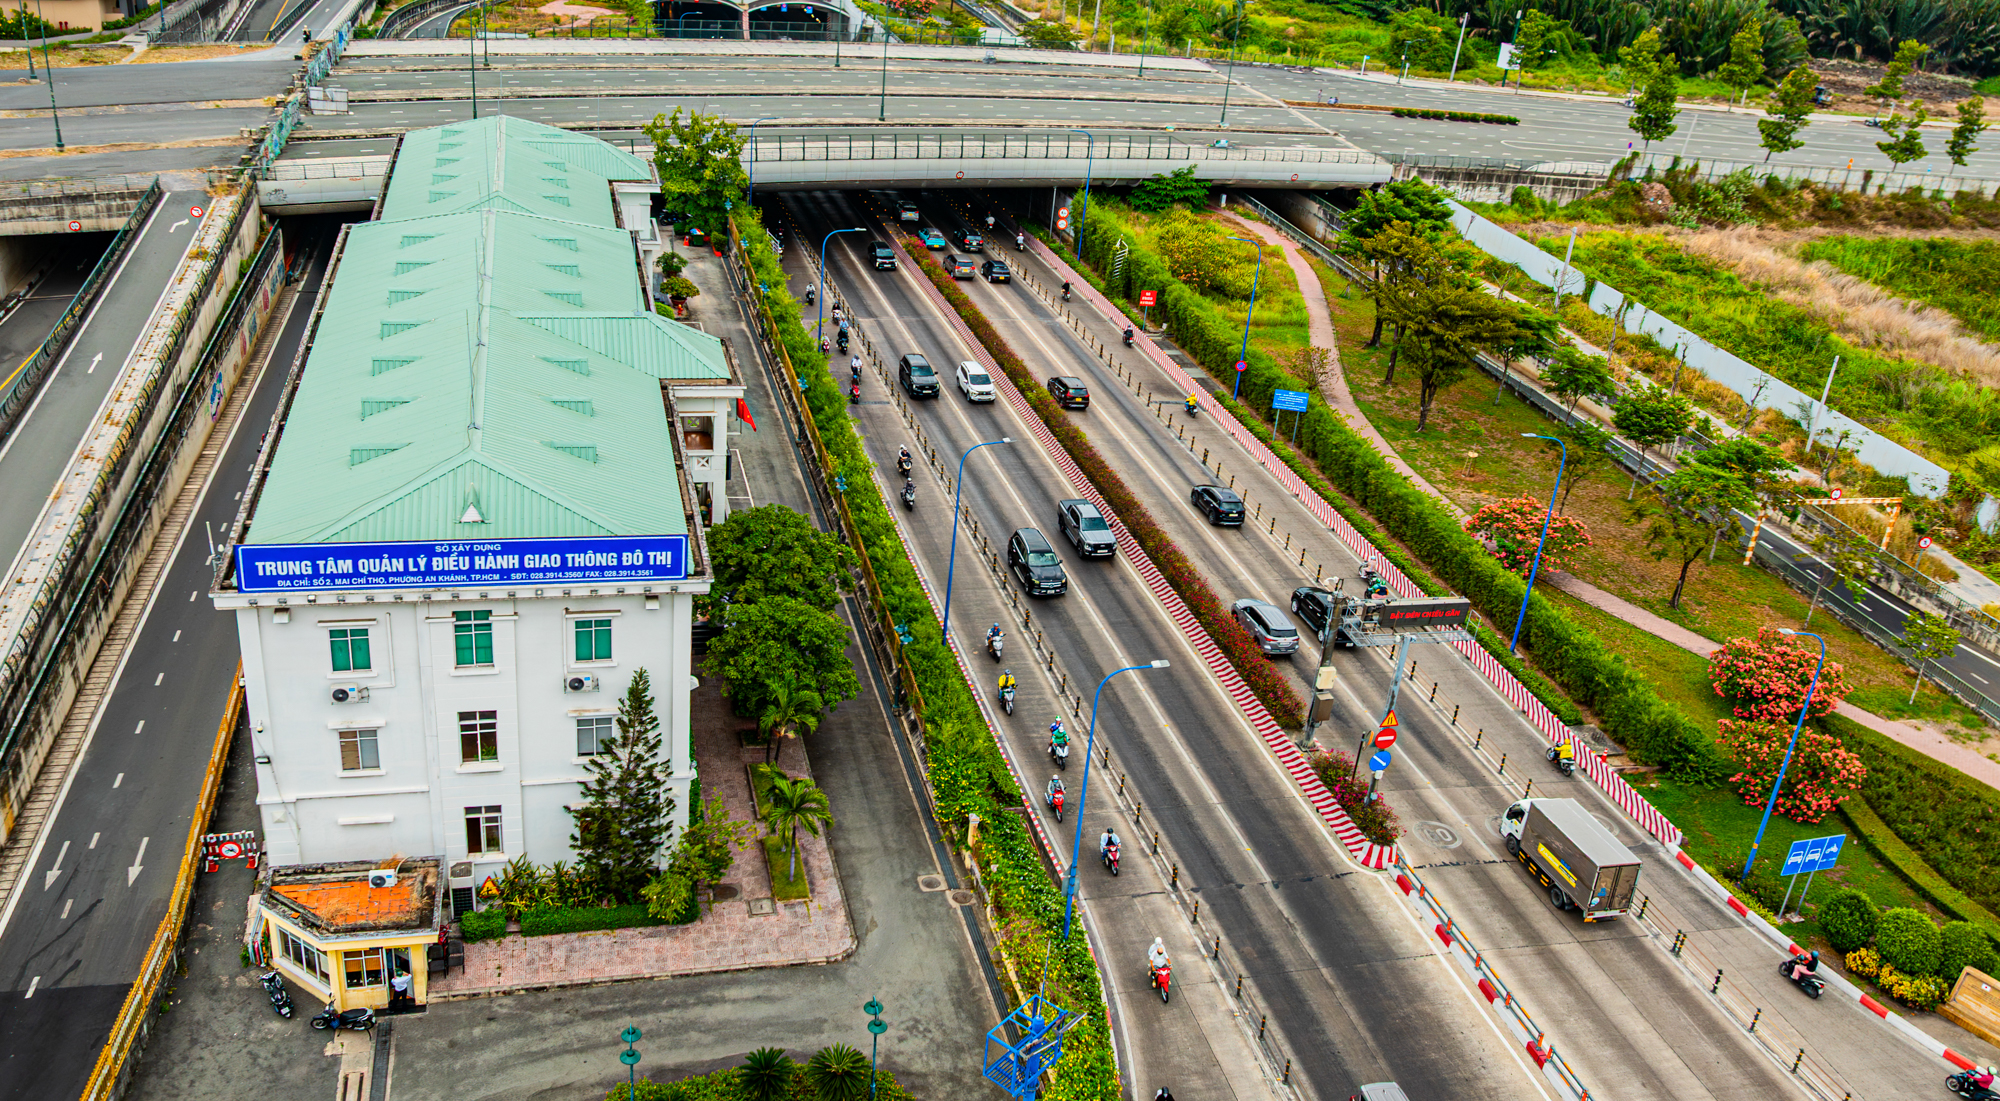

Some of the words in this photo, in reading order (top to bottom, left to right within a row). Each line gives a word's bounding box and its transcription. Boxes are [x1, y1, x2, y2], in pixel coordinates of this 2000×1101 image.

[451, 543, 471, 552] XÂY
[473, 543, 501, 552] DỰNG
[254, 560, 313, 576] TRUNG
[316, 556, 353, 575] TÂM
[357, 553, 405, 575] QUẢN
[407, 554, 427, 572] LÝ
[431, 551, 470, 572] ĐIỀU
[474, 552, 519, 570] HÀNH
[524, 553, 562, 569] GIAO
[565, 550, 618, 568] THÔNG
[621, 549, 643, 566] ĐÔ
[647, 551, 672, 568] THỊ
[277, 579, 292, 588] ĐỊA
[312, 576, 325, 586] SỐ
[351, 576, 366, 585] CHÍ
[388, 575, 423, 584] PHƯỜNG
